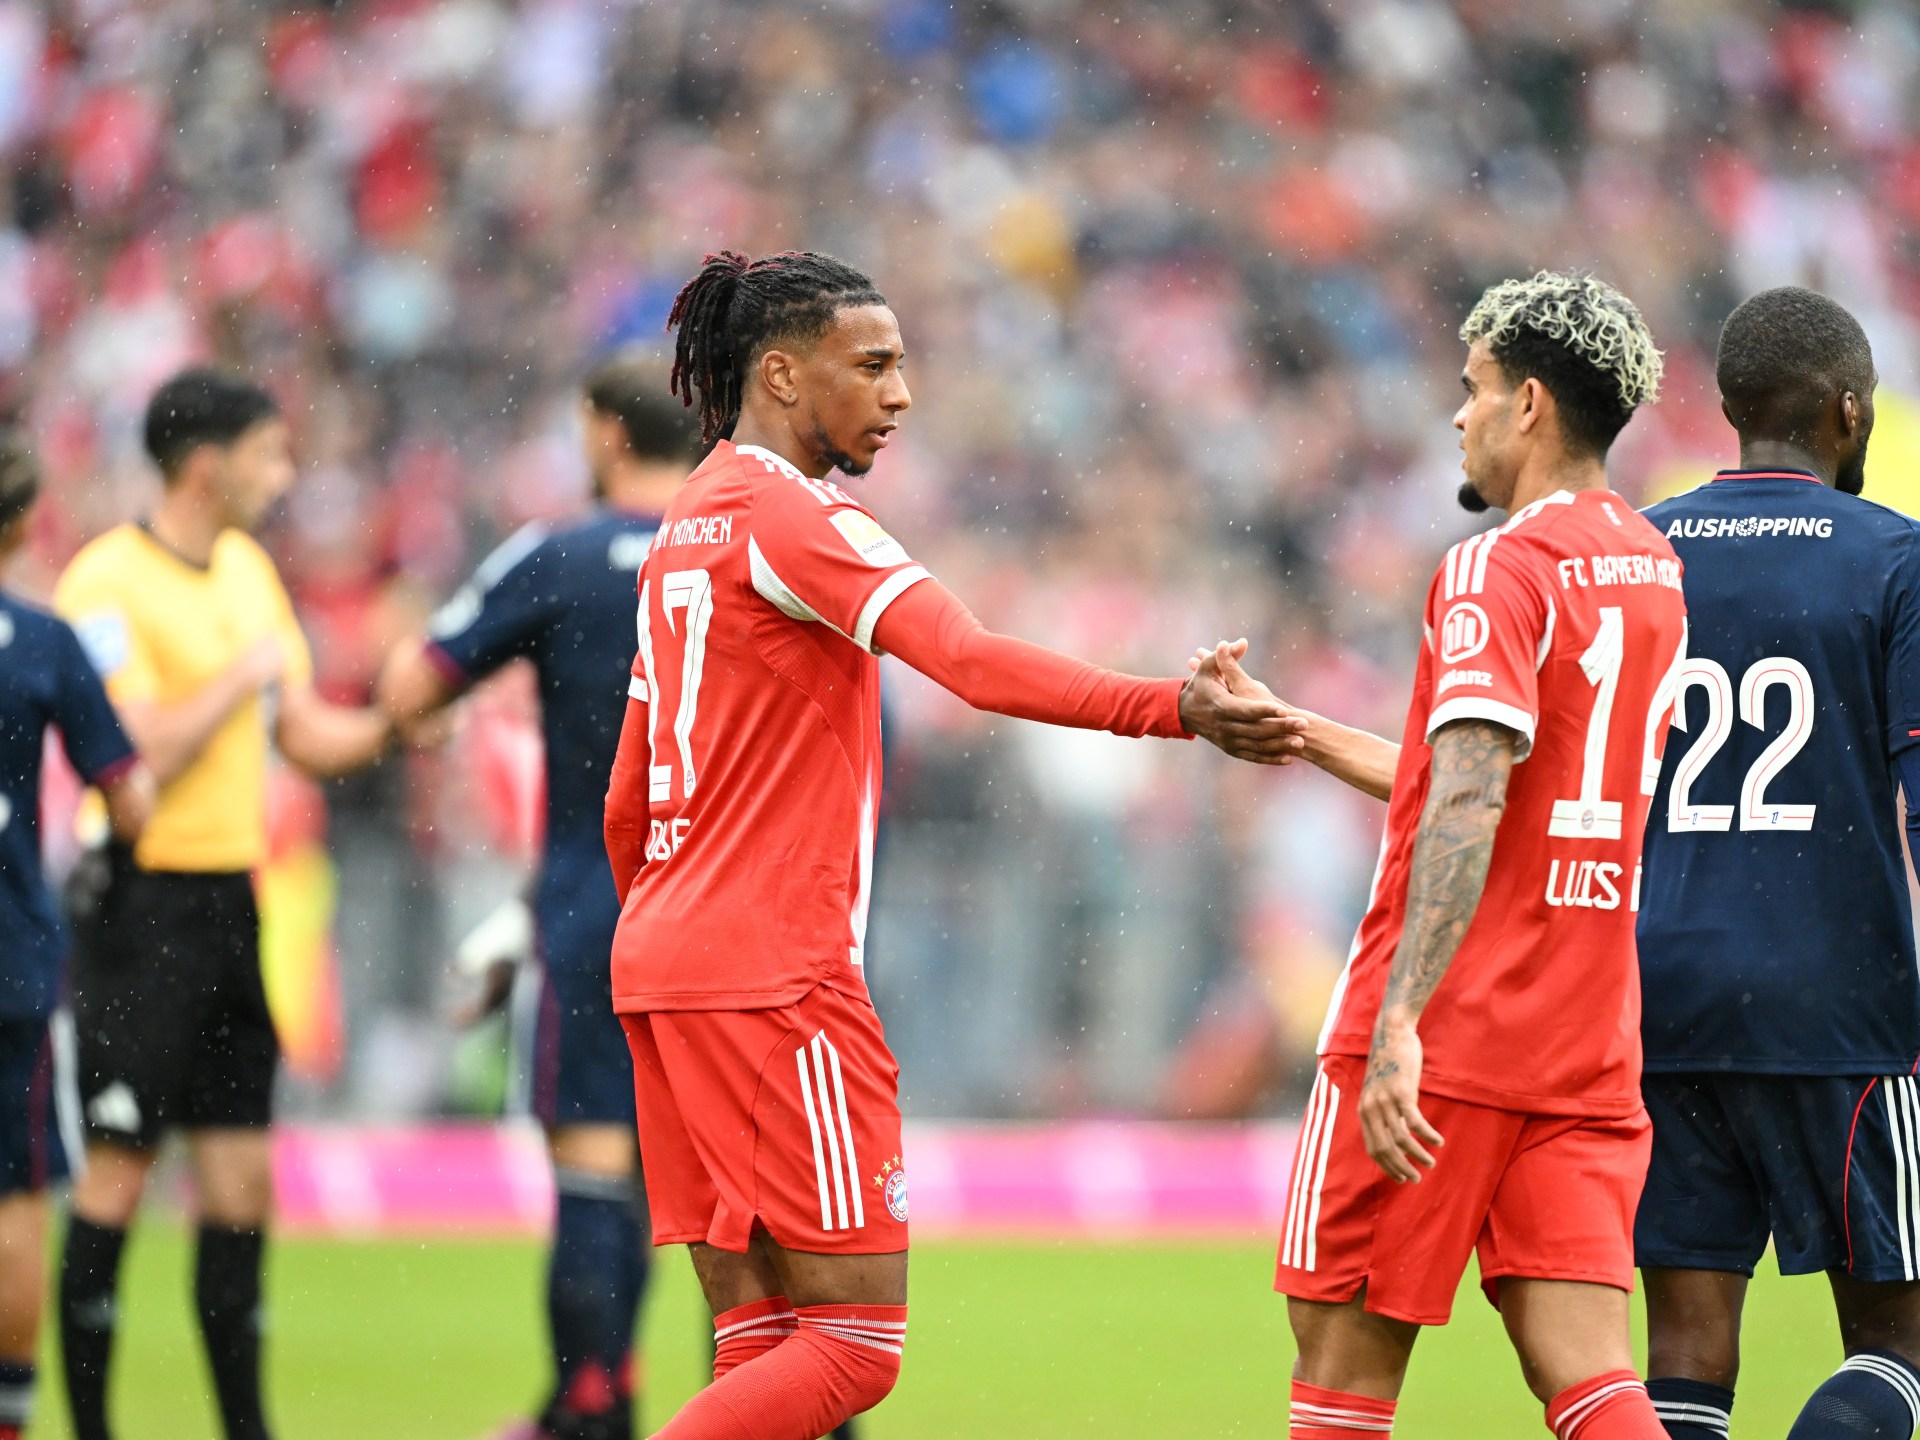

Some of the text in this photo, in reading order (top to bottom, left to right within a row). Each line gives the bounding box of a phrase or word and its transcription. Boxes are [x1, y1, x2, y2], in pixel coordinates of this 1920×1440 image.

[1558, 557, 1588, 589] FC
[1591, 554, 1656, 586] BAYERN
[637, 568, 713, 803] 17
[1668, 656, 1816, 833] 22
[1545, 859, 1623, 910] LUIS
